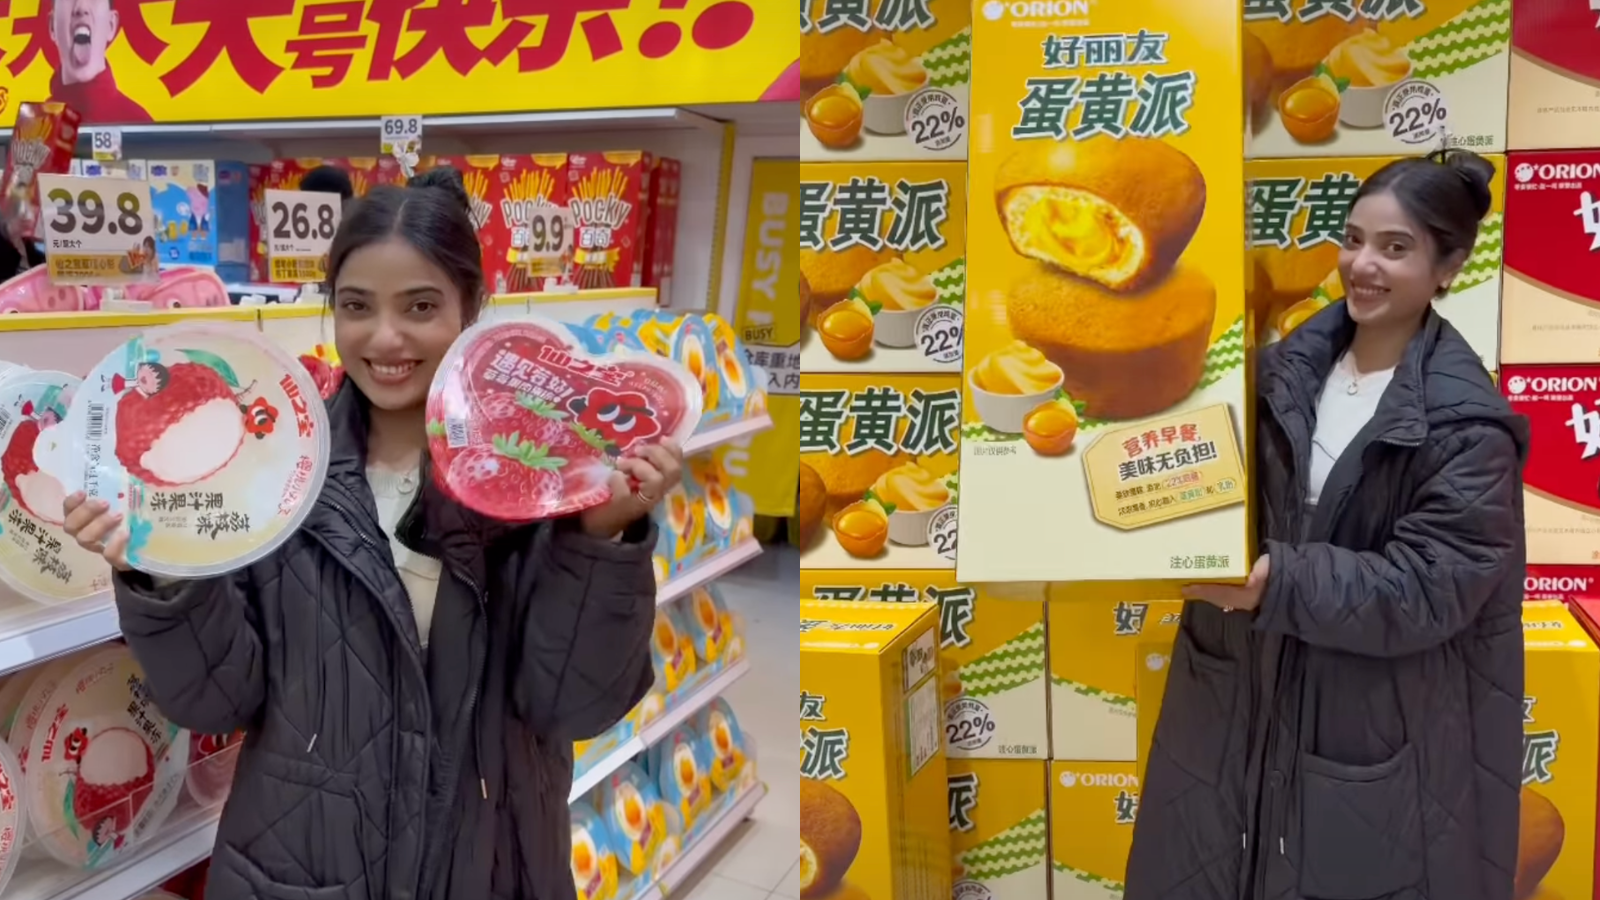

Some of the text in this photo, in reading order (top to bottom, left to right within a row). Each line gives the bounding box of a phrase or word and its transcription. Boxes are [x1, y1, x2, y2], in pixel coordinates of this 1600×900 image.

[1011, 0, 1089, 17] ORION
[1042, 29, 1169, 67] 好丽友
[1012, 72, 1196, 140] 蛋黄派
[1389, 97, 1447, 138] 22%
[94, 132, 112, 149] 58
[384, 118, 418, 135] 69.8
[911, 106, 965, 144] 22%
[47, 187, 143, 236] 39.8
[271, 201, 335, 240] 26.8
[532, 214, 564, 252] 9.9
[754, 191, 790, 300] BUSY
[745, 327, 773, 341] BUSY
[1531, 376, 1597, 393] ORION
[279, 373, 314, 438] 仙之宝
[1119, 441, 1217, 481] 美味无负担!
[150, 492, 223, 512] 果汁果冻
[195, 511, 250, 540] 荔枝味
[1169, 555, 1230, 569] 注心蛋黄派
[1524, 576, 1588, 592] ORION
[41, 703, 69, 763] 仙之宝
[946, 713, 995, 745] 22%
[1081, 773, 1139, 787] ORION
